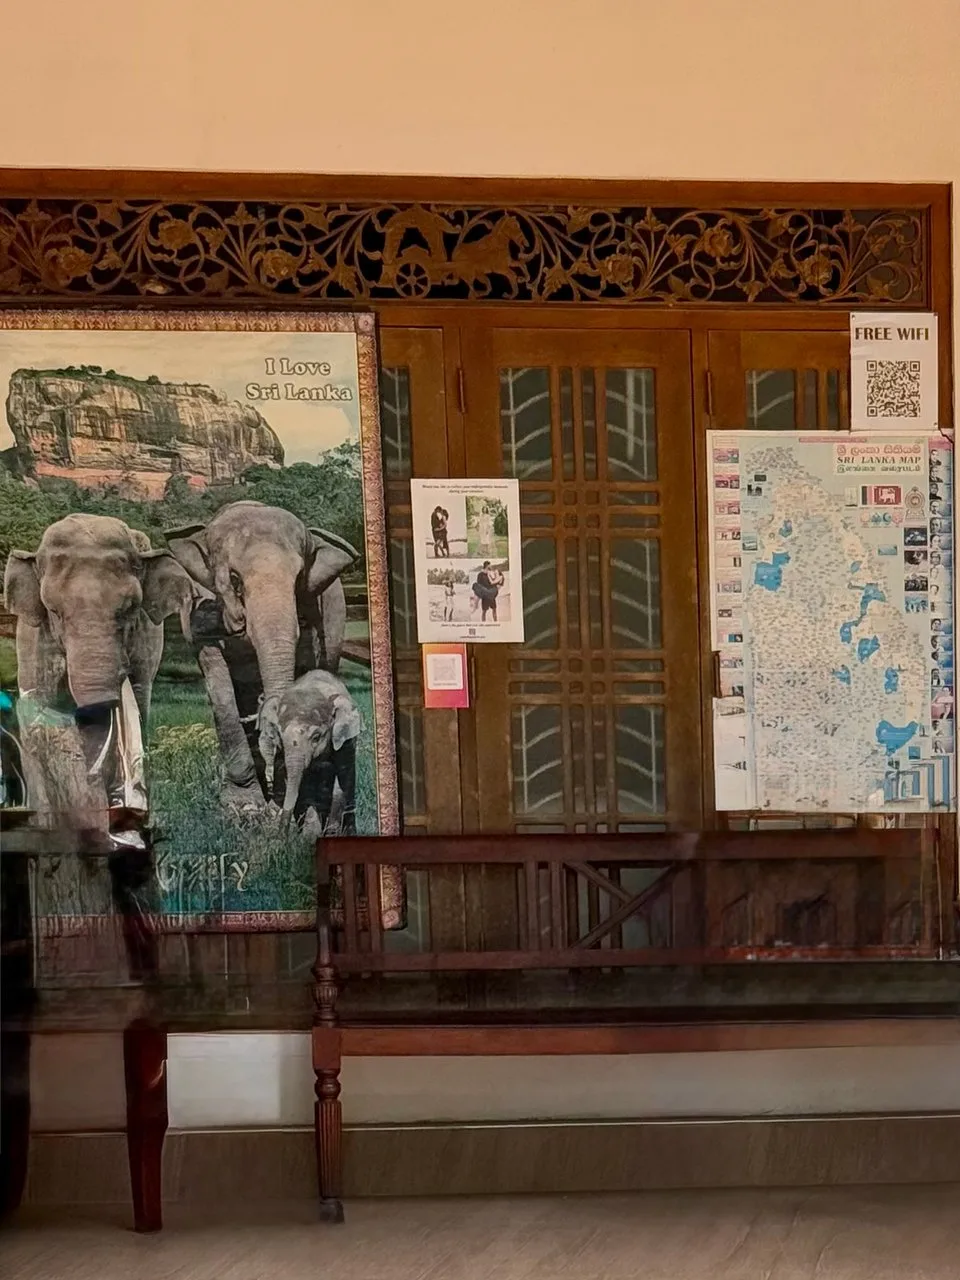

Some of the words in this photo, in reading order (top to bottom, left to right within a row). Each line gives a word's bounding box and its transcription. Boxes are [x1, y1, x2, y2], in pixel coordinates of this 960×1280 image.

[854, 327, 892, 341] FREE
[897, 327, 929, 341] WIFI
[265, 358, 276, 375] I
[280, 357, 331, 376] Love
[245, 382, 281, 400] Sri
[283, 383, 352, 401] Lanka
[836, 456, 855, 464] SRI
[861, 456, 896, 464] LANKA
[898, 456, 922, 464] MAP
